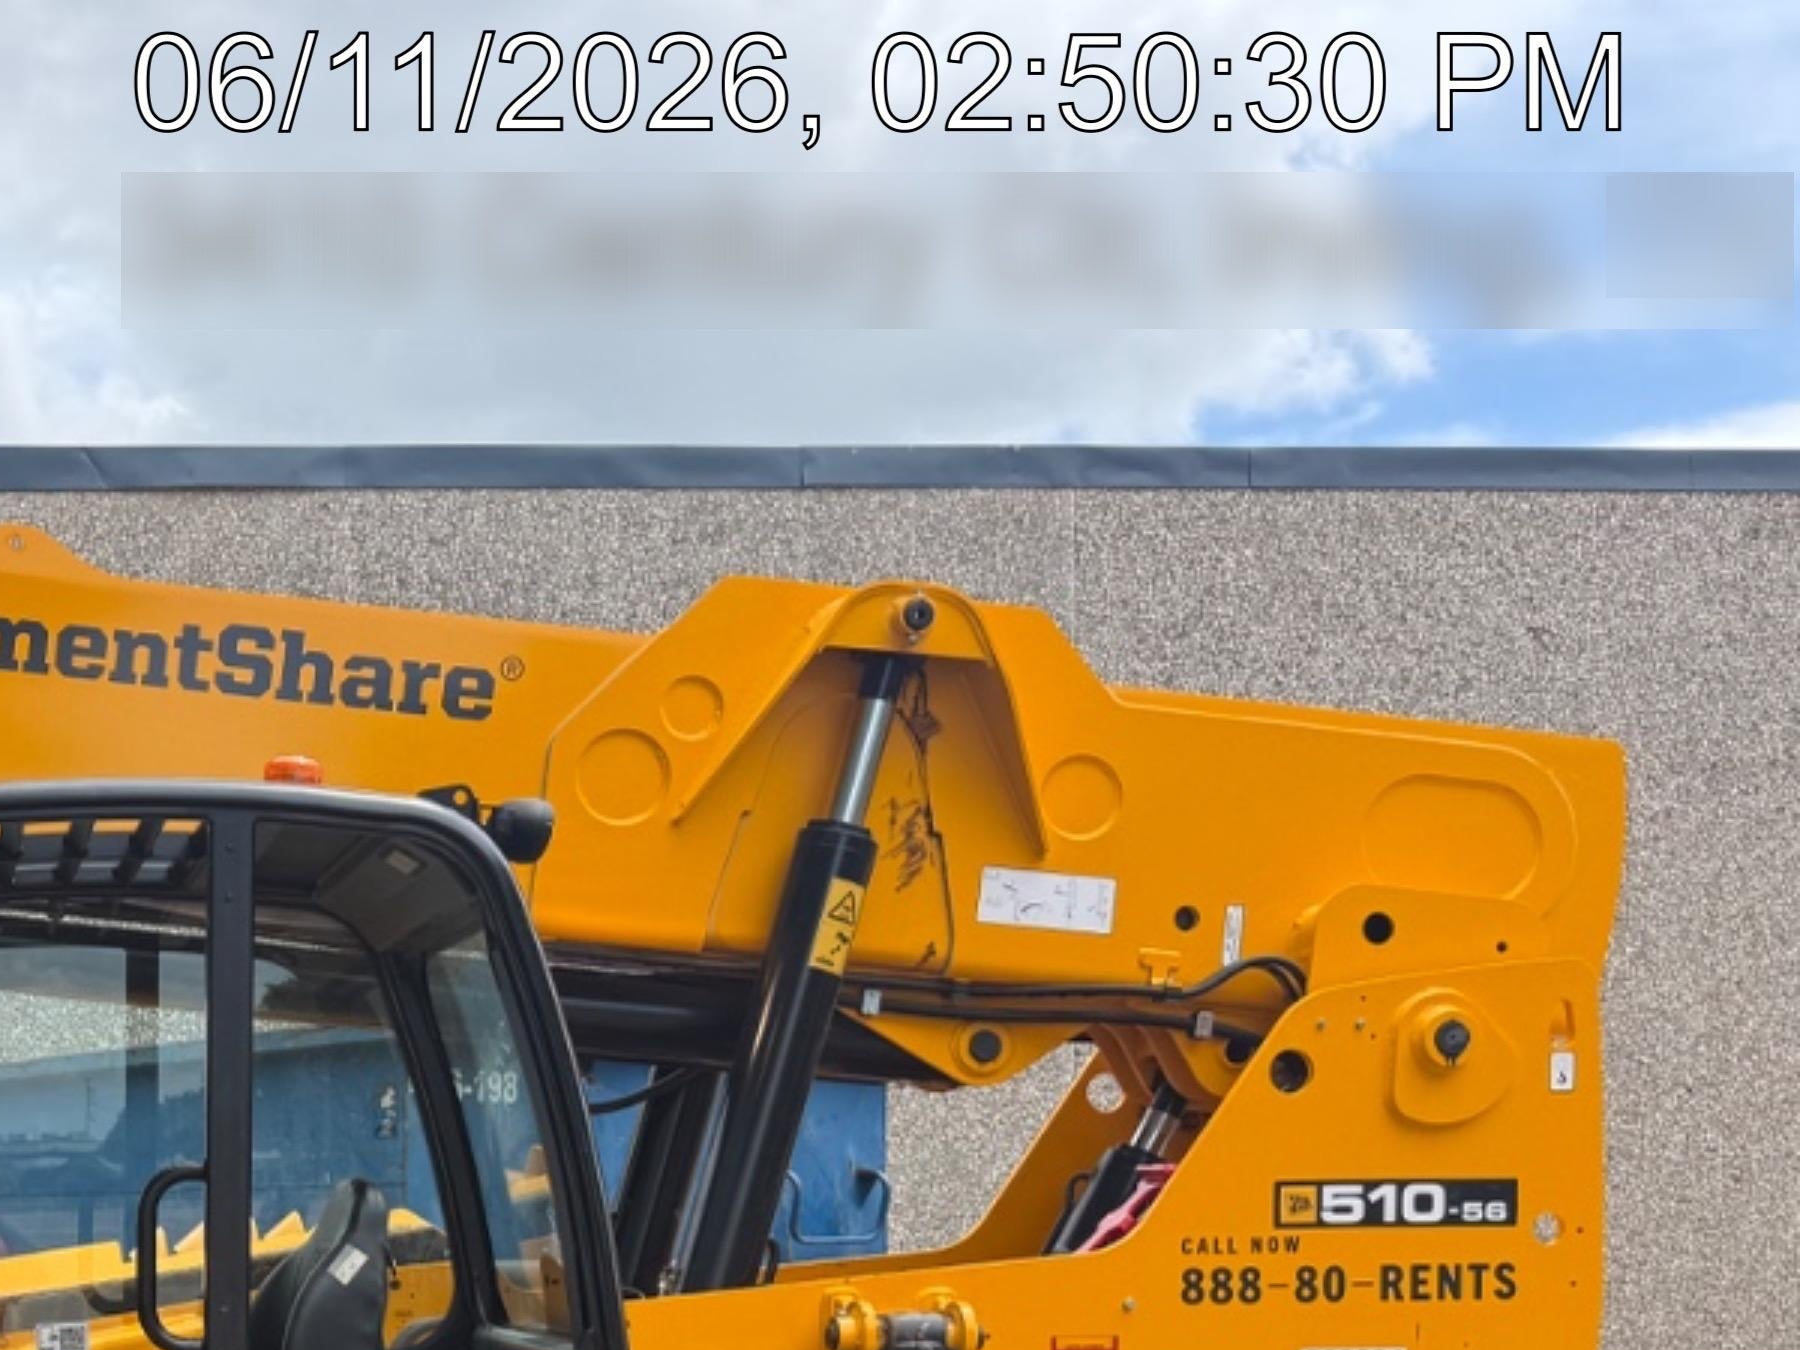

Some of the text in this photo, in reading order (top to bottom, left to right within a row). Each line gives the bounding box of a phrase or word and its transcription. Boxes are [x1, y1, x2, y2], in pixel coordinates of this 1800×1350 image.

[1320, 1183, 1507, 1223] 510-56
[1181, 1236, 1301, 1255] CALL NOW
[1180, 1262, 1518, 1305] 888-80-RENTS
